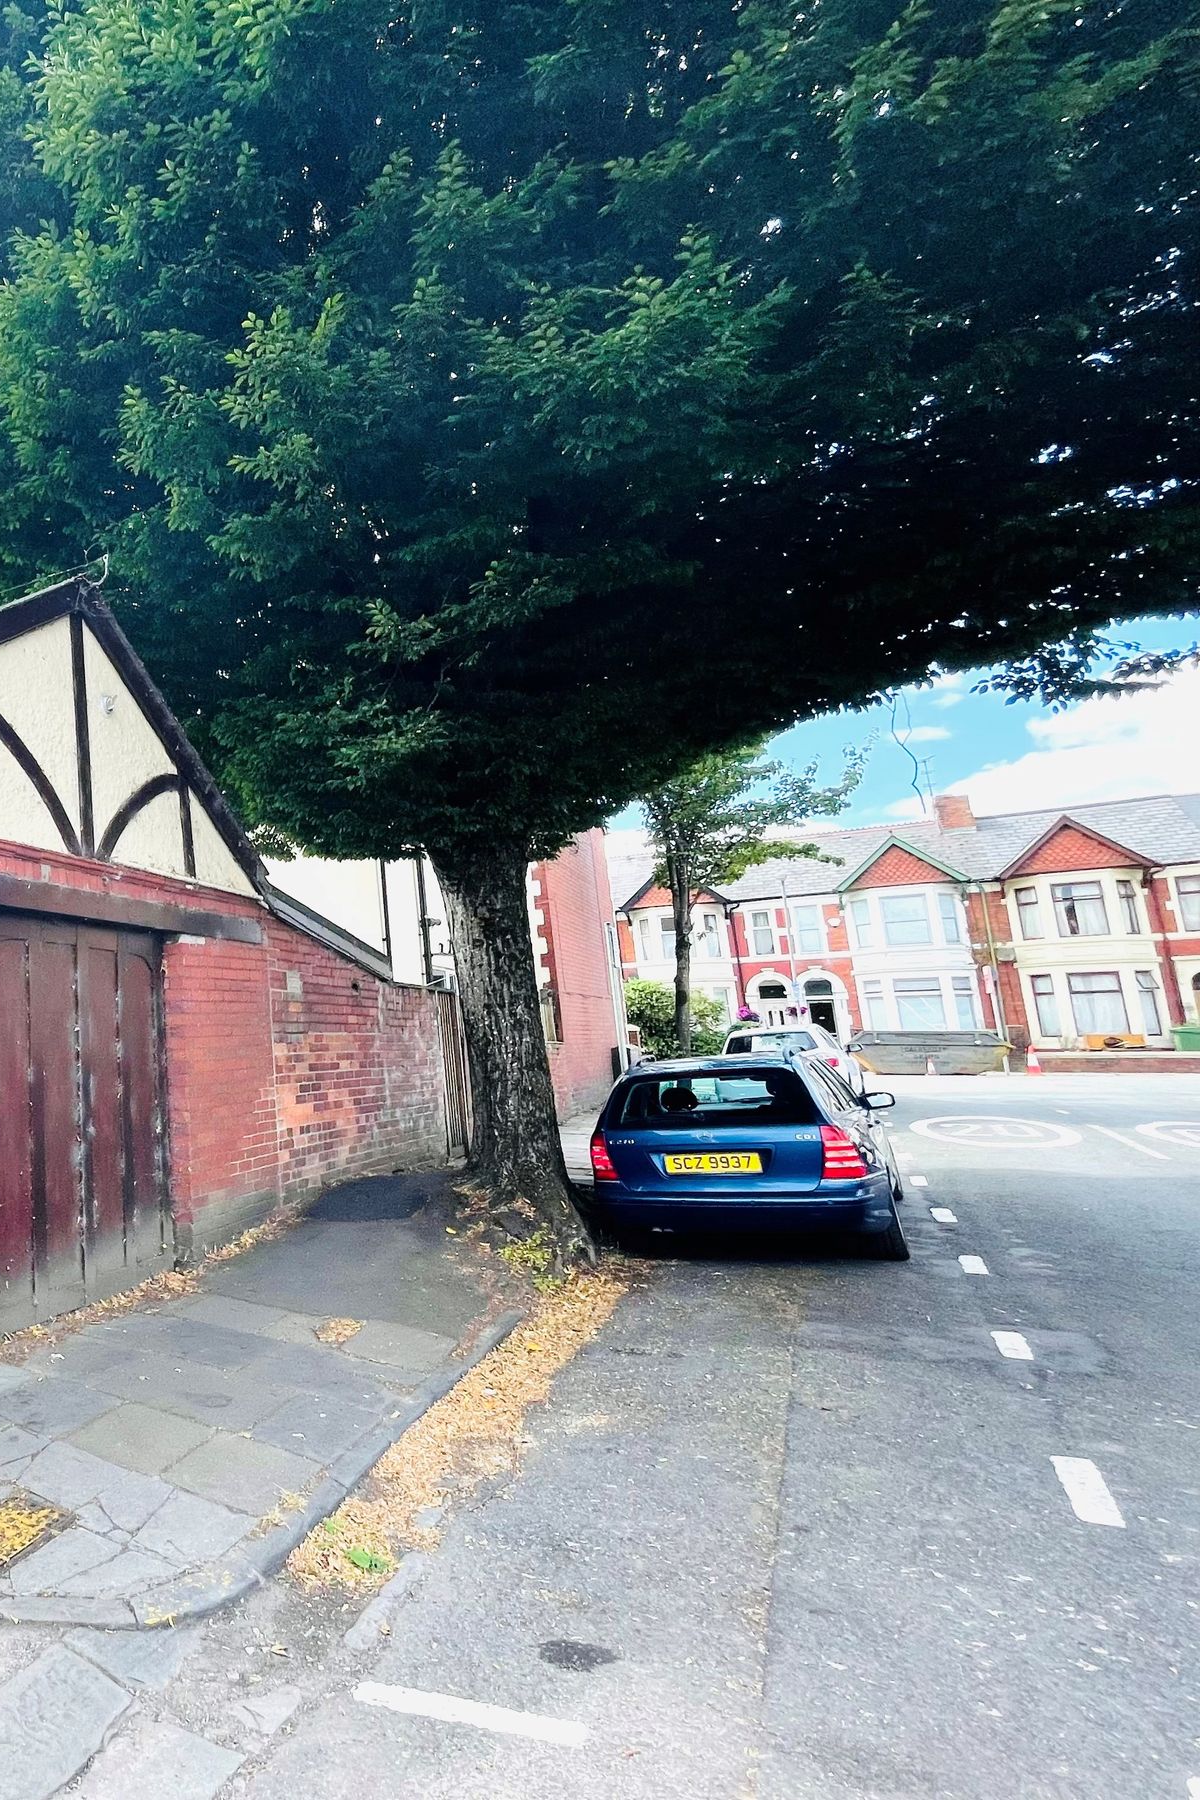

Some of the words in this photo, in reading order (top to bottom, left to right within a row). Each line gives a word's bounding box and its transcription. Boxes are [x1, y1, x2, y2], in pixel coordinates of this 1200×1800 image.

[939, 1123, 1044, 1137] 20
[673, 1157, 704, 1170] SCZ
[708, 1156, 751, 1169] 9937
